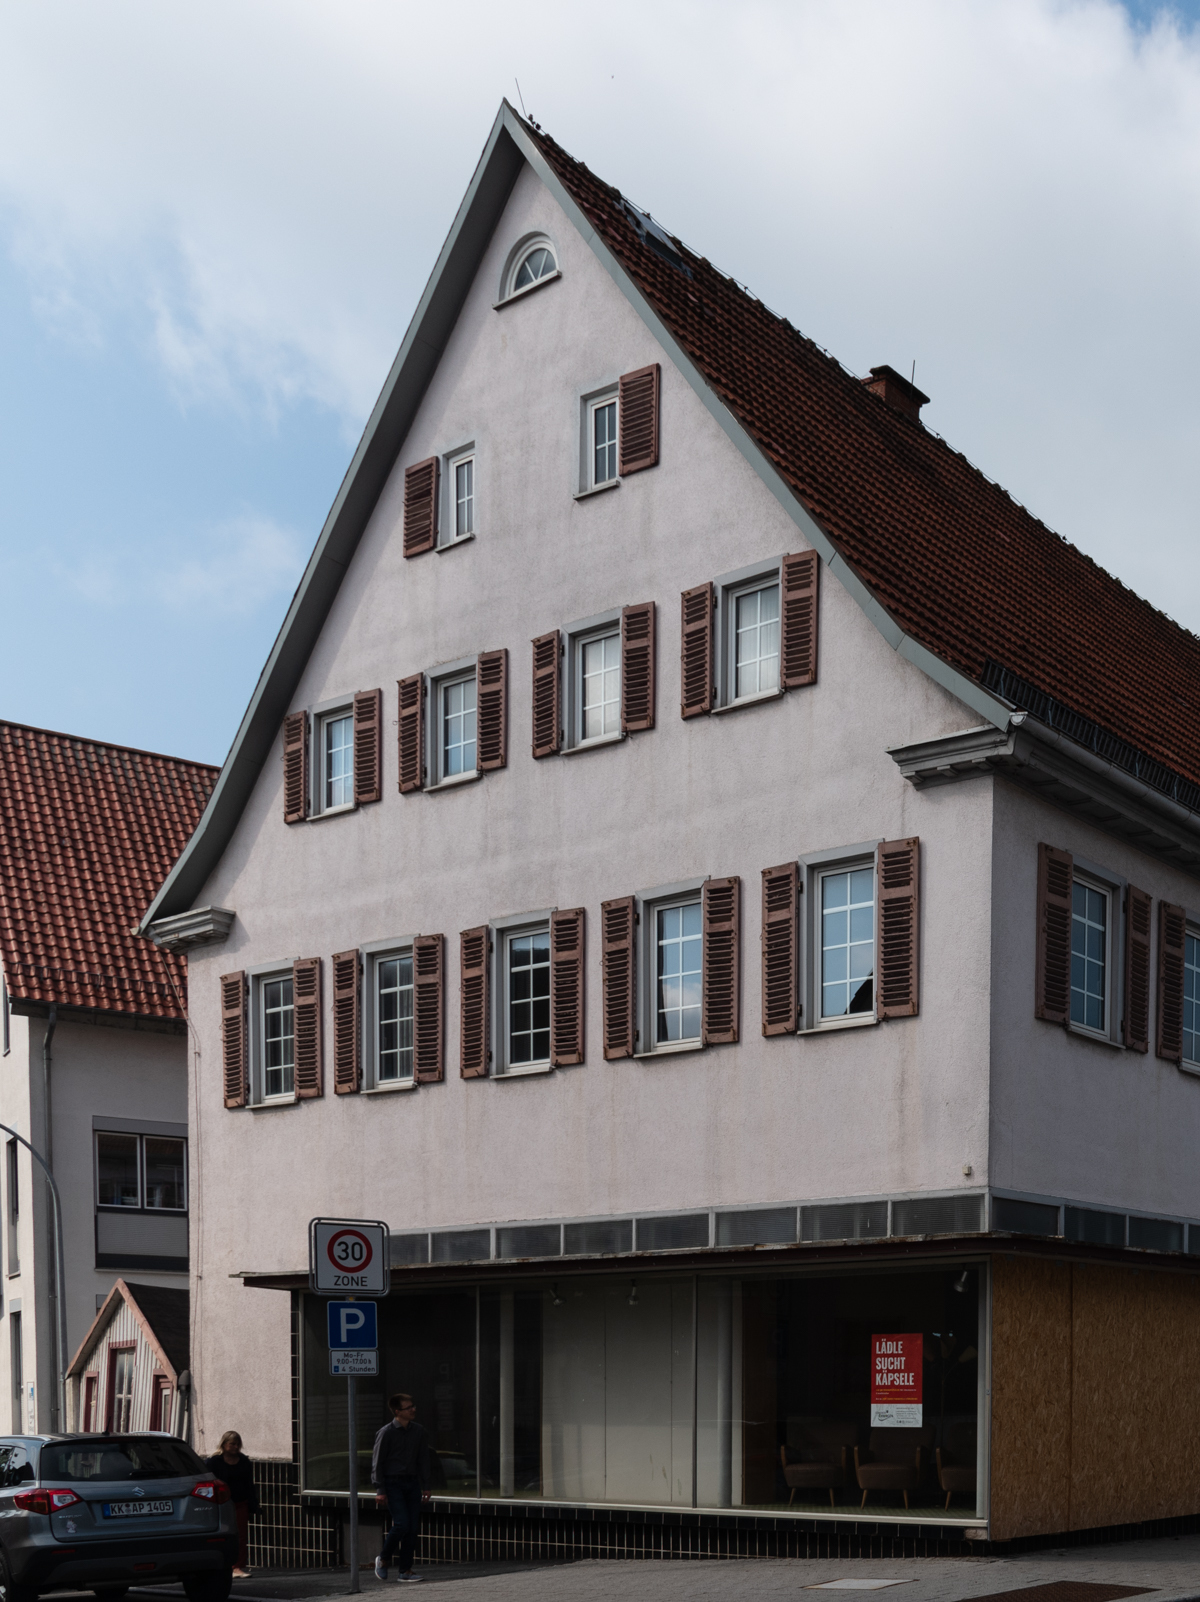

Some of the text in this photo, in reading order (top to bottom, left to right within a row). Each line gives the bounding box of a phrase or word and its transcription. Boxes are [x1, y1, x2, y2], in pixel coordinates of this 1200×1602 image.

[336, 1241, 363, 1261] 30
[333, 1275, 368, 1287] ZONE
[340, 1308, 365, 1343] P
[875, 1338, 903, 1354] LÄDLE
[875, 1357, 906, 1370] SUCHT
[875, 1370, 915, 1386] KÄPSELE
[110, 1501, 172, 1515] KK AP 1405
